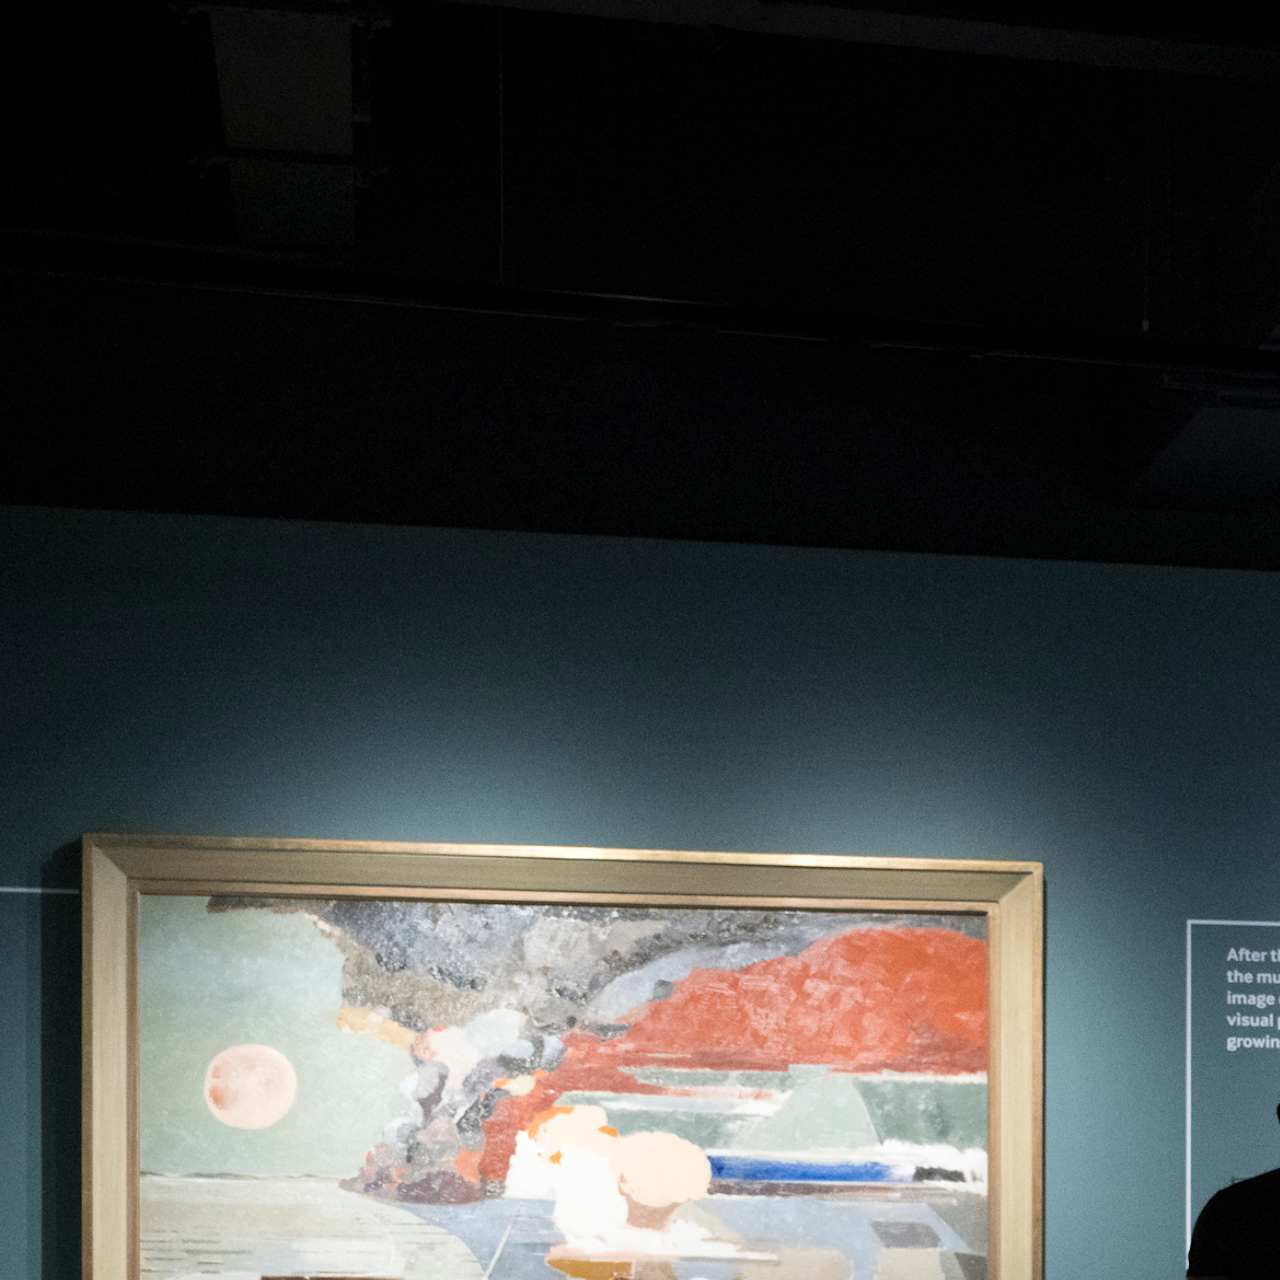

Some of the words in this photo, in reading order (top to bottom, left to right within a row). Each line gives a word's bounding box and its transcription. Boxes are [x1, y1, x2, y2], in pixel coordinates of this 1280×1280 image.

[1227, 948, 1267, 962] After
[1227, 970, 1253, 983] the
[1227, 991, 1275, 1008] image
[1227, 1013, 1273, 1027] visual
